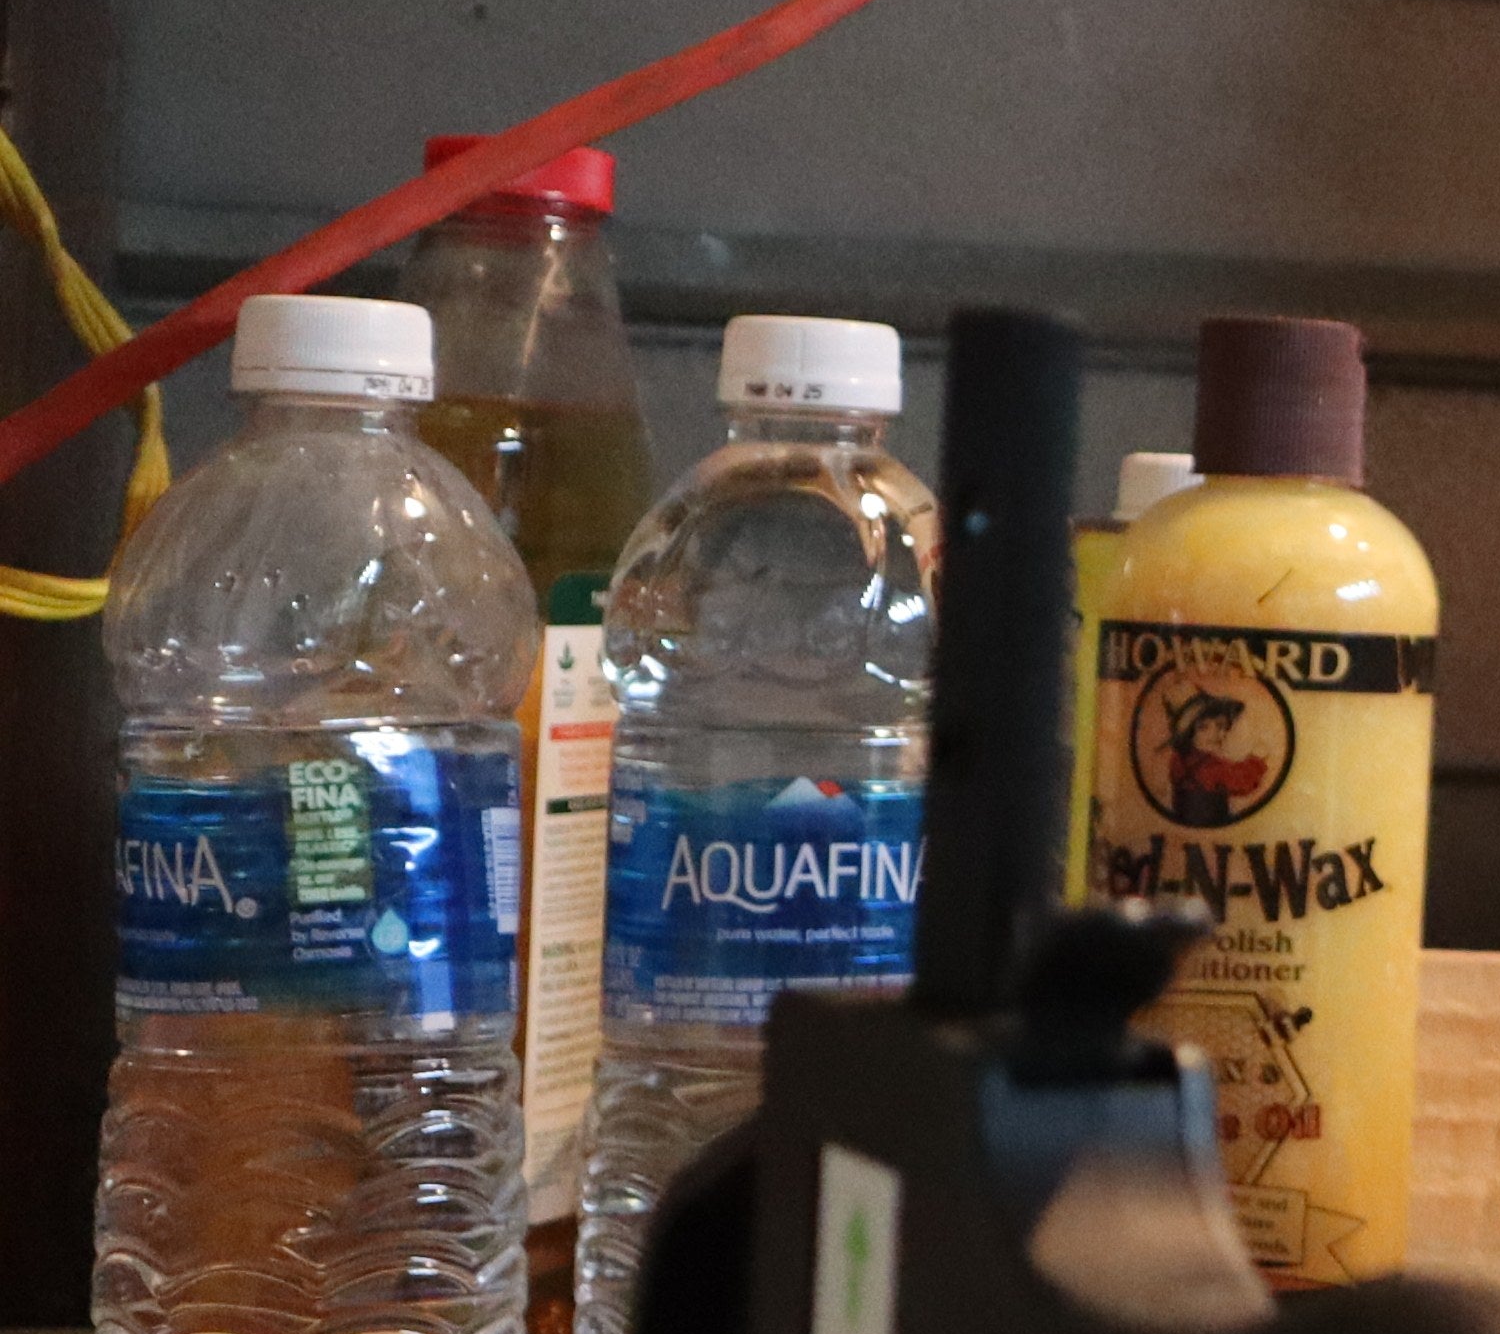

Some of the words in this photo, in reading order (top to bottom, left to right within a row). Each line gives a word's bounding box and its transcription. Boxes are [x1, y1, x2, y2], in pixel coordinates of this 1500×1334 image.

[1107, 629, 1351, 683] HOWARD
[289, 760, 359, 786] ECO-
[292, 784, 362, 810] FINA
[1211, 927, 1293, 954] olish
